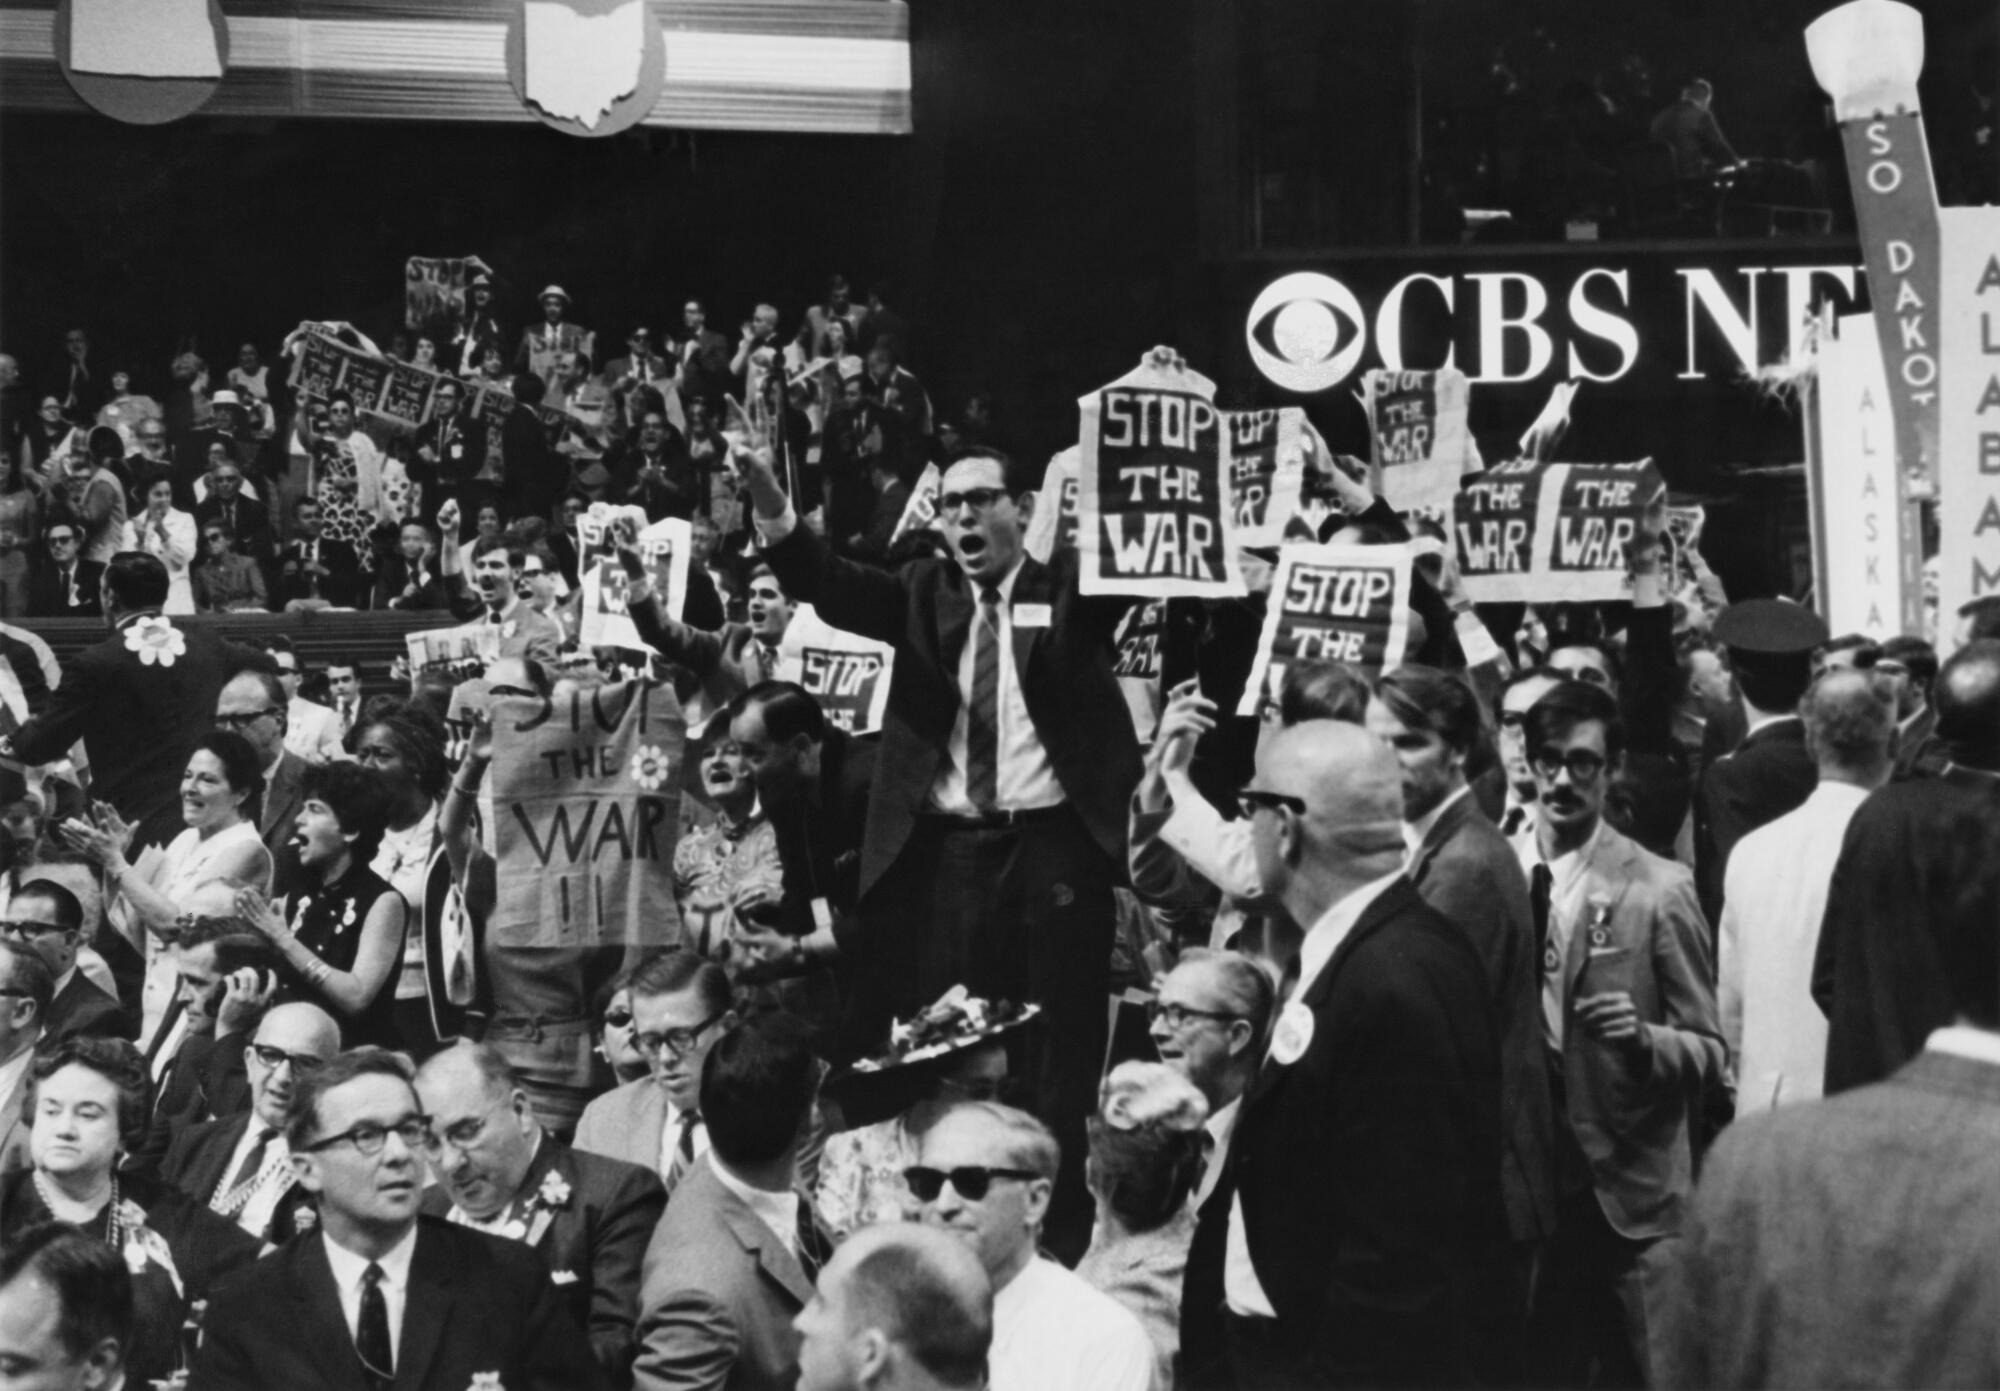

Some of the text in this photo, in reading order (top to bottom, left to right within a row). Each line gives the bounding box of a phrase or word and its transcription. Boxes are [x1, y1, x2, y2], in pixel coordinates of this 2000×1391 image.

[1866, 122, 1902, 193] SO
[1375, 268, 1639, 383] CBS
[1104, 392, 1214, 452] STOP
[1384, 399, 1426, 425] THE
[1377, 423, 1429, 462] WAR
[1119, 465, 1203, 503] THE
[1466, 482, 1526, 512] THE
[1575, 480, 1638, 508] THE
[1858, 386, 1884, 629] ALASKA
[1102, 512, 1214, 580] WAR
[1458, 518, 1527, 571] WAR
[1560, 517, 1636, 569] WAR
[1285, 567, 1391, 618] STOP
[1291, 626, 1367, 662] THE
[803, 652, 882, 696] STOP
[540, 745, 619, 780] THE
[511, 795, 666, 867] WAR
